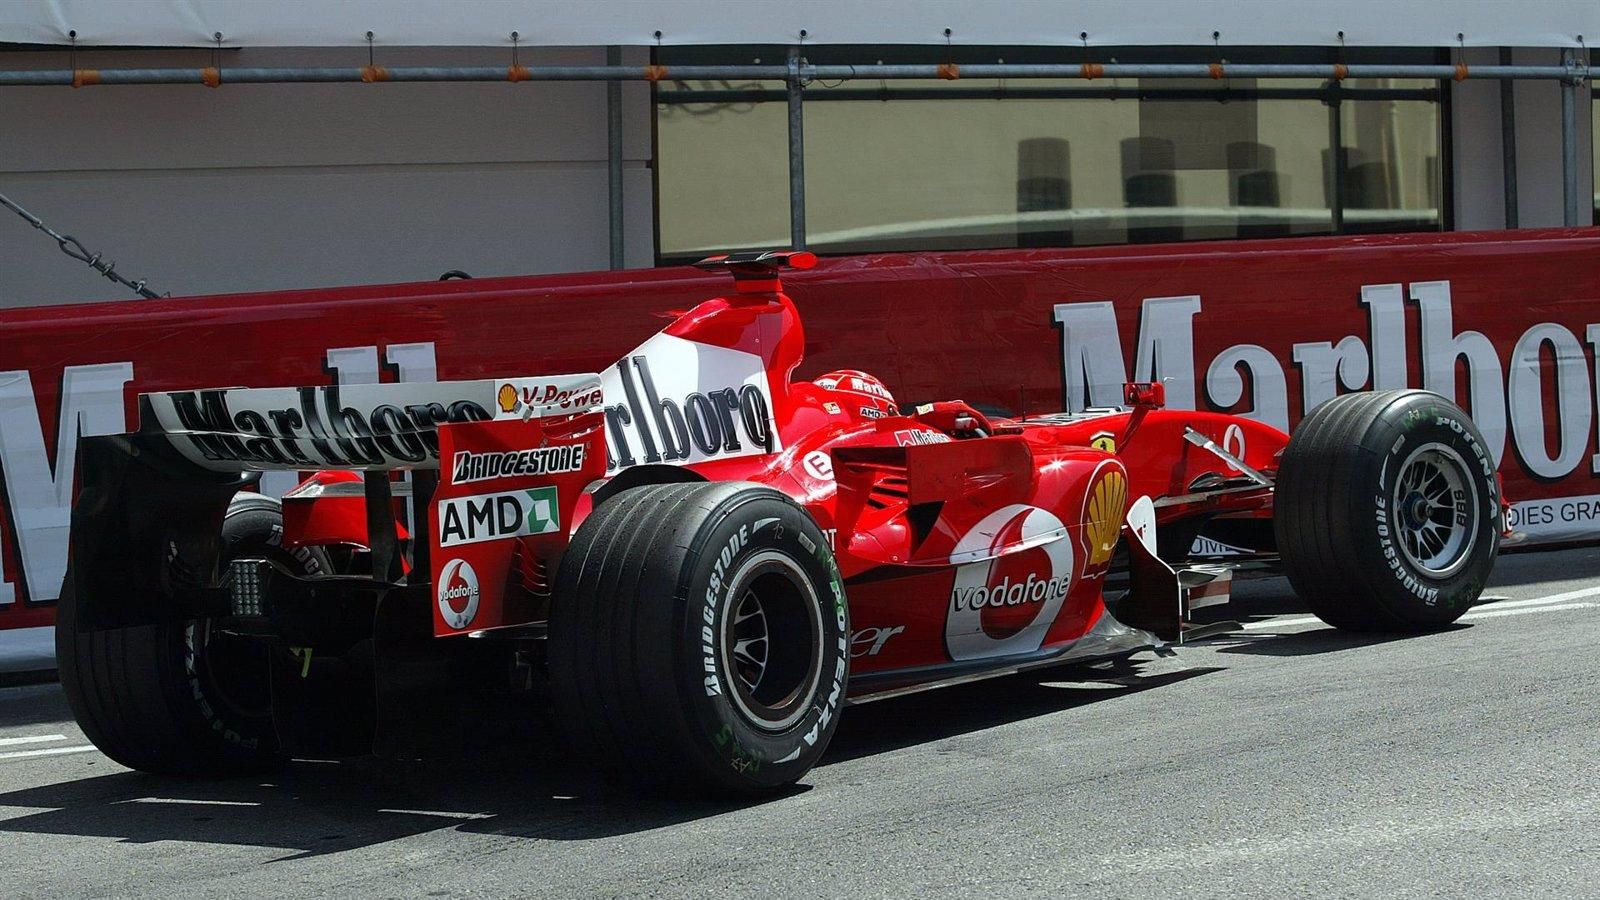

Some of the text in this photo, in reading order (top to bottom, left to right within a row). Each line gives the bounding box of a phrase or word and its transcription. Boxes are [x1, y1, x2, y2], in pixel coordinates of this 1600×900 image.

[605, 355, 770, 471] rlboro
[1053, 280, 1600, 480] Marlbo
[452, 445, 583, 484] BRIDGESTONE
[1436, 416, 1497, 520] POTENZA
[1453, 489, 1466, 528] BBS
[441, 495, 524, 545] AMD
[1374, 494, 1440, 607] BRIDGESTONE
[700, 523, 749, 697] BRIDGESTONE
[952, 570, 1071, 612] vodafone
[802, 580, 848, 747] POTENZA
